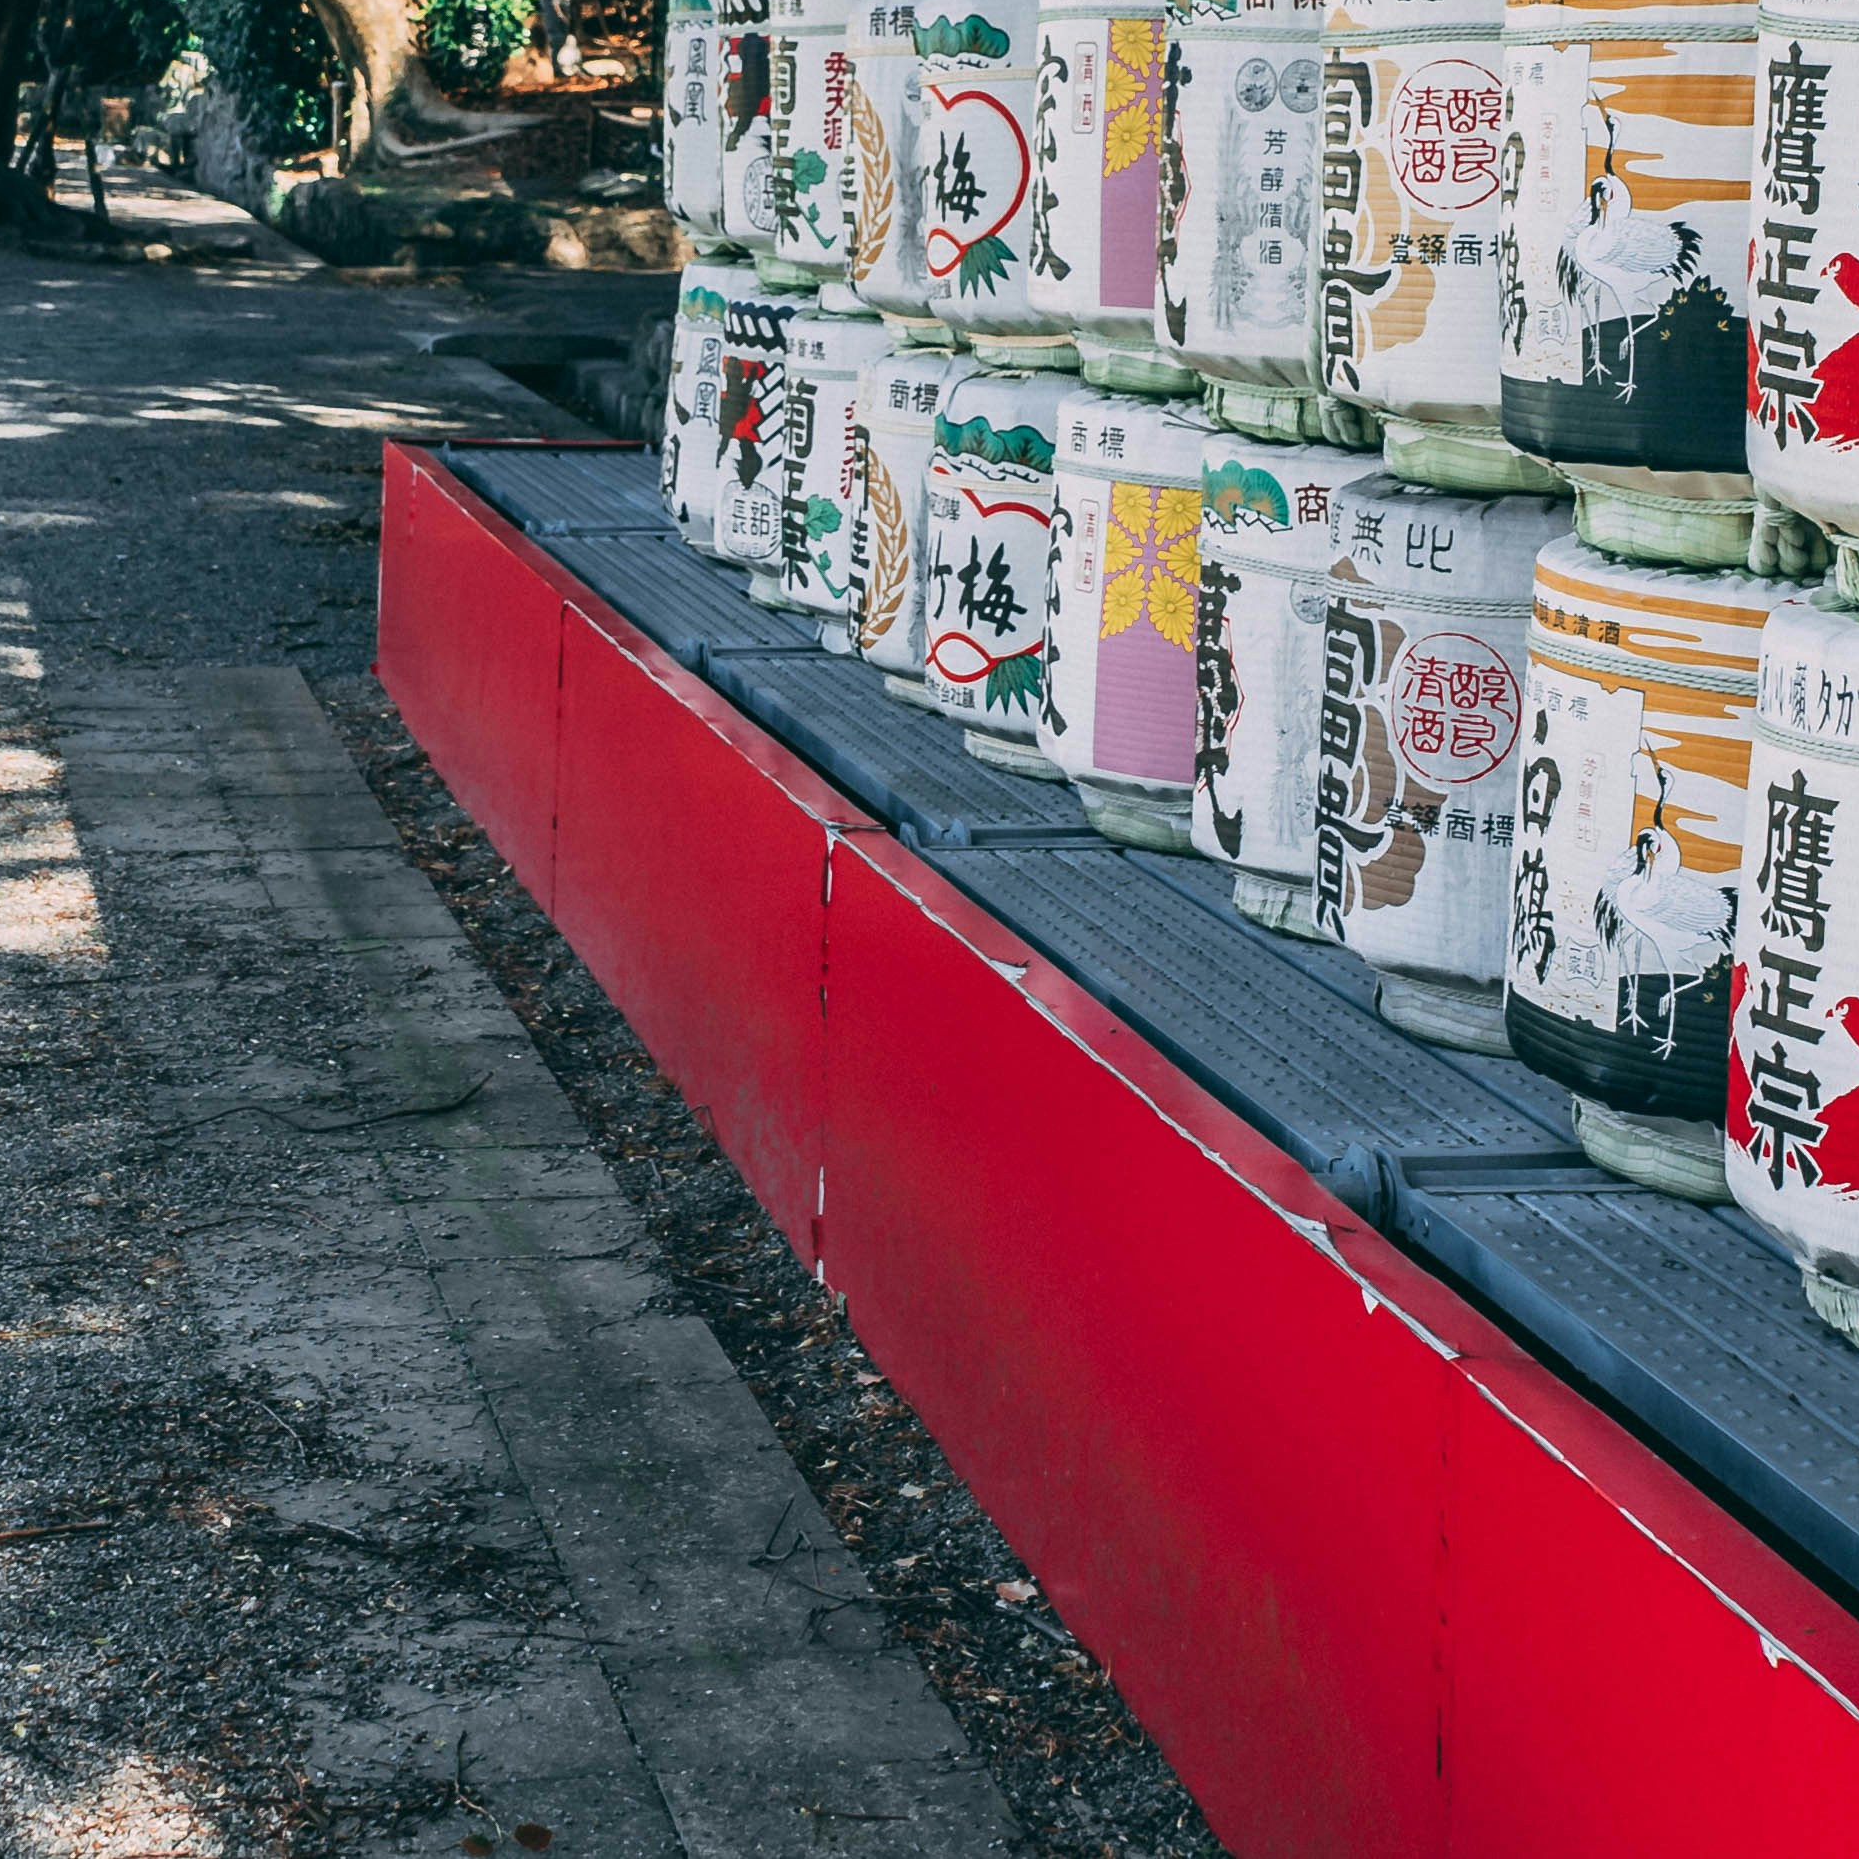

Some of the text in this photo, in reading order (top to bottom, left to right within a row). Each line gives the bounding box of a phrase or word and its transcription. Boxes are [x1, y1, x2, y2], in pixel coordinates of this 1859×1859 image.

[1260, 130, 1286, 265] 芳醇清酒
[1756, 40, 1832, 450] 鷹正宗
[1070, 420, 1125, 460] 商標
[1748, 768, 1840, 1190] 鷹正宗
